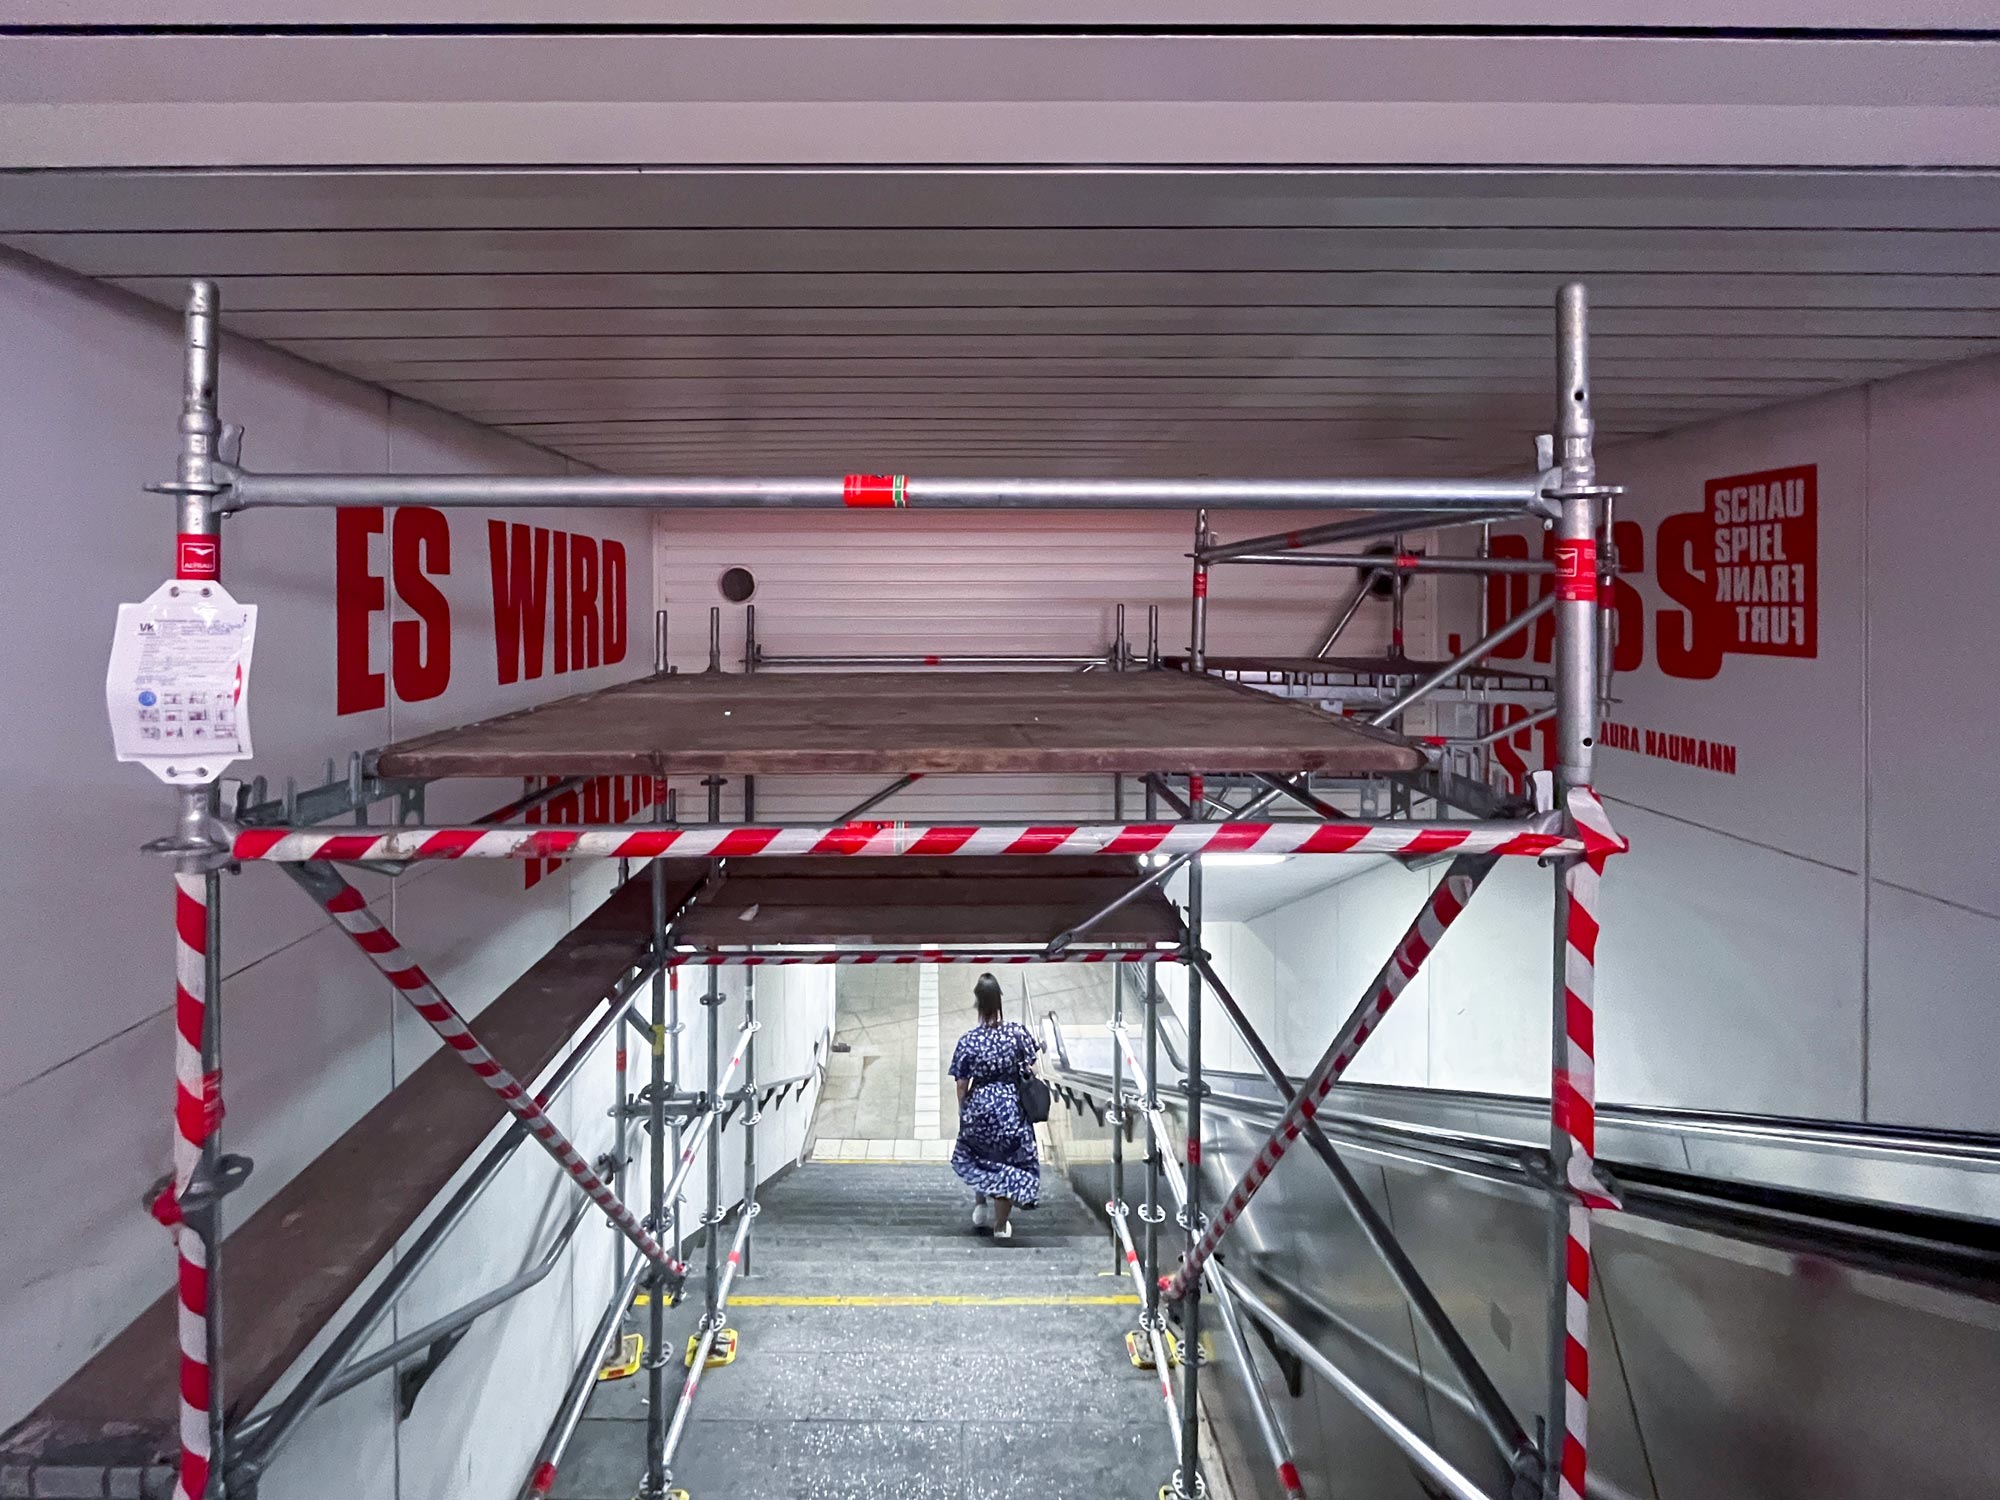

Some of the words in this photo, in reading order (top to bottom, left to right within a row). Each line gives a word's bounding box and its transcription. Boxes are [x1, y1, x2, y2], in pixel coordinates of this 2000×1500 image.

[1714, 478, 1805, 525] SCHAU
[1714, 523, 1787, 563] SPIEL
[337, 506, 451, 717] ES
[487, 519, 627, 686] WIRD
[1597, 721, 1640, 753] AURA
[1645, 729, 1737, 775] NAUMANN
